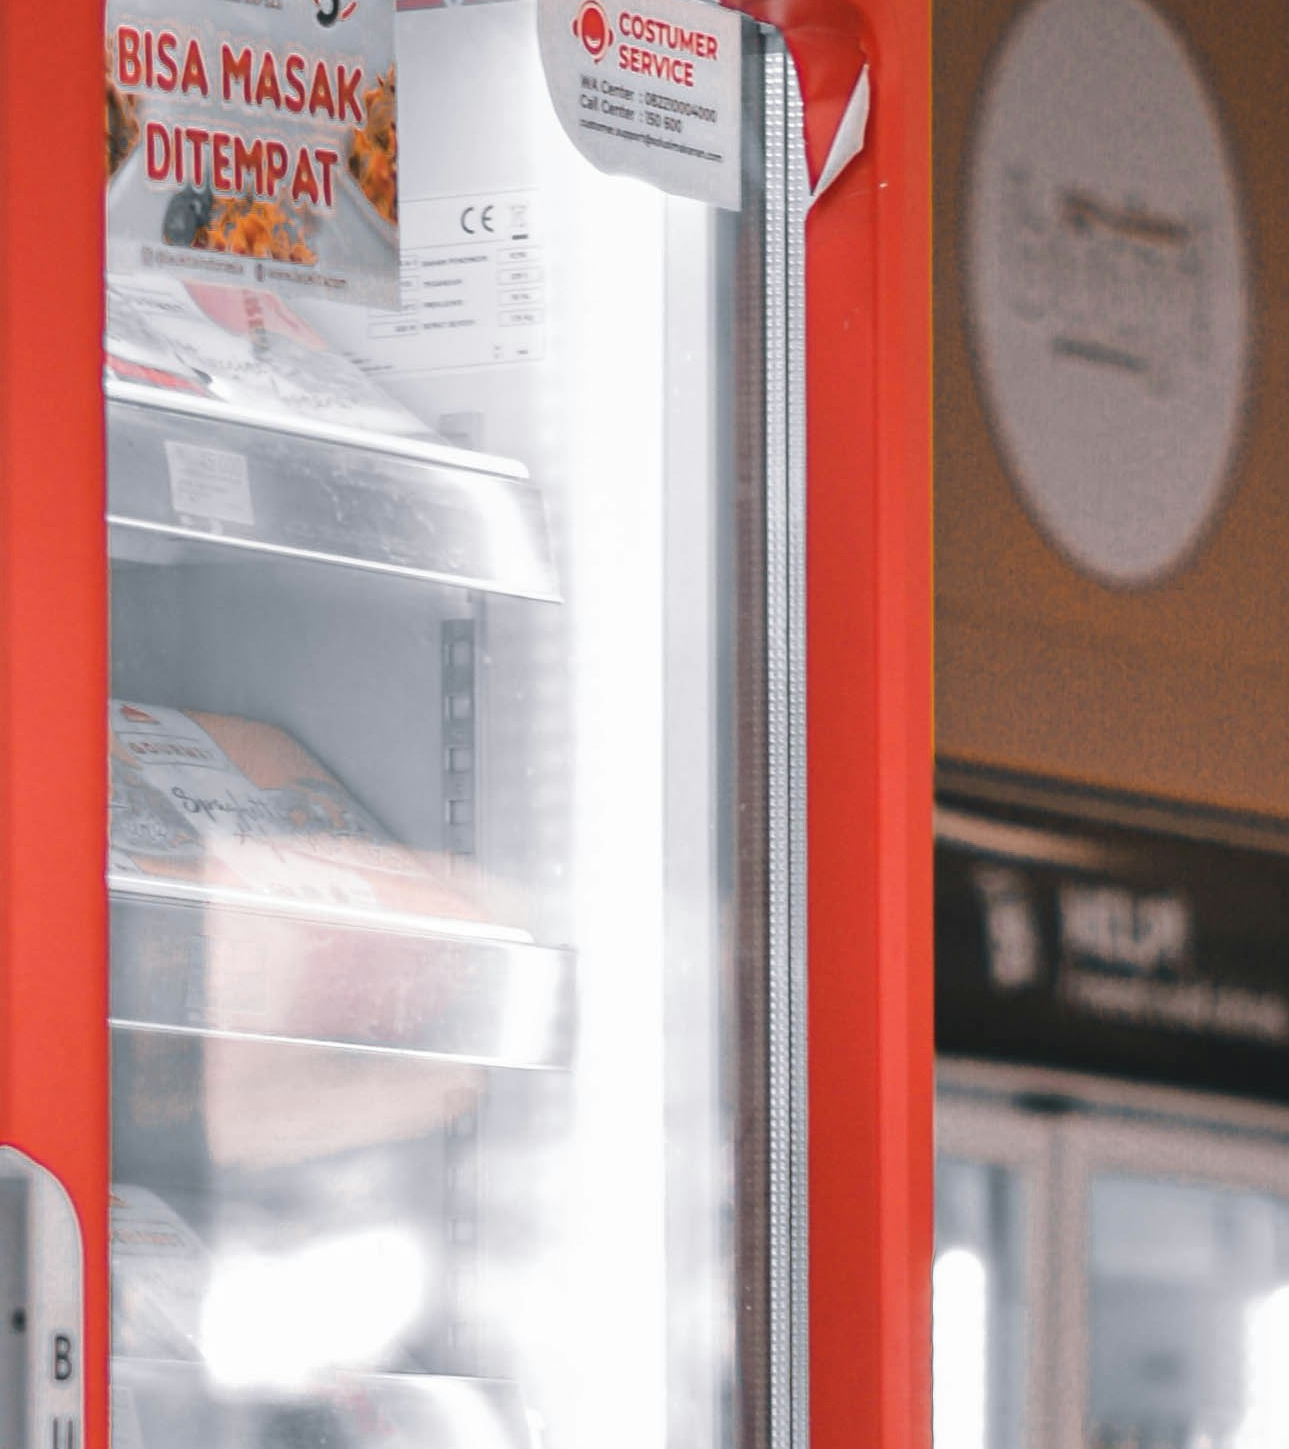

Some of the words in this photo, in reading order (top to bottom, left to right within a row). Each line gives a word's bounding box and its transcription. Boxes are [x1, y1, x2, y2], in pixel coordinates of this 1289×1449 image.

[618, 12, 719, 61] COSTUMER
[117, 25, 209, 98] BISA
[221, 43, 364, 123] MASAK
[618, 44, 695, 88] SERVICE
[579, 94, 599, 111] Call
[601, 100, 635, 120] Center
[601, 80, 635, 101] Center
[146, 121, 338, 207] DITEMPAT
